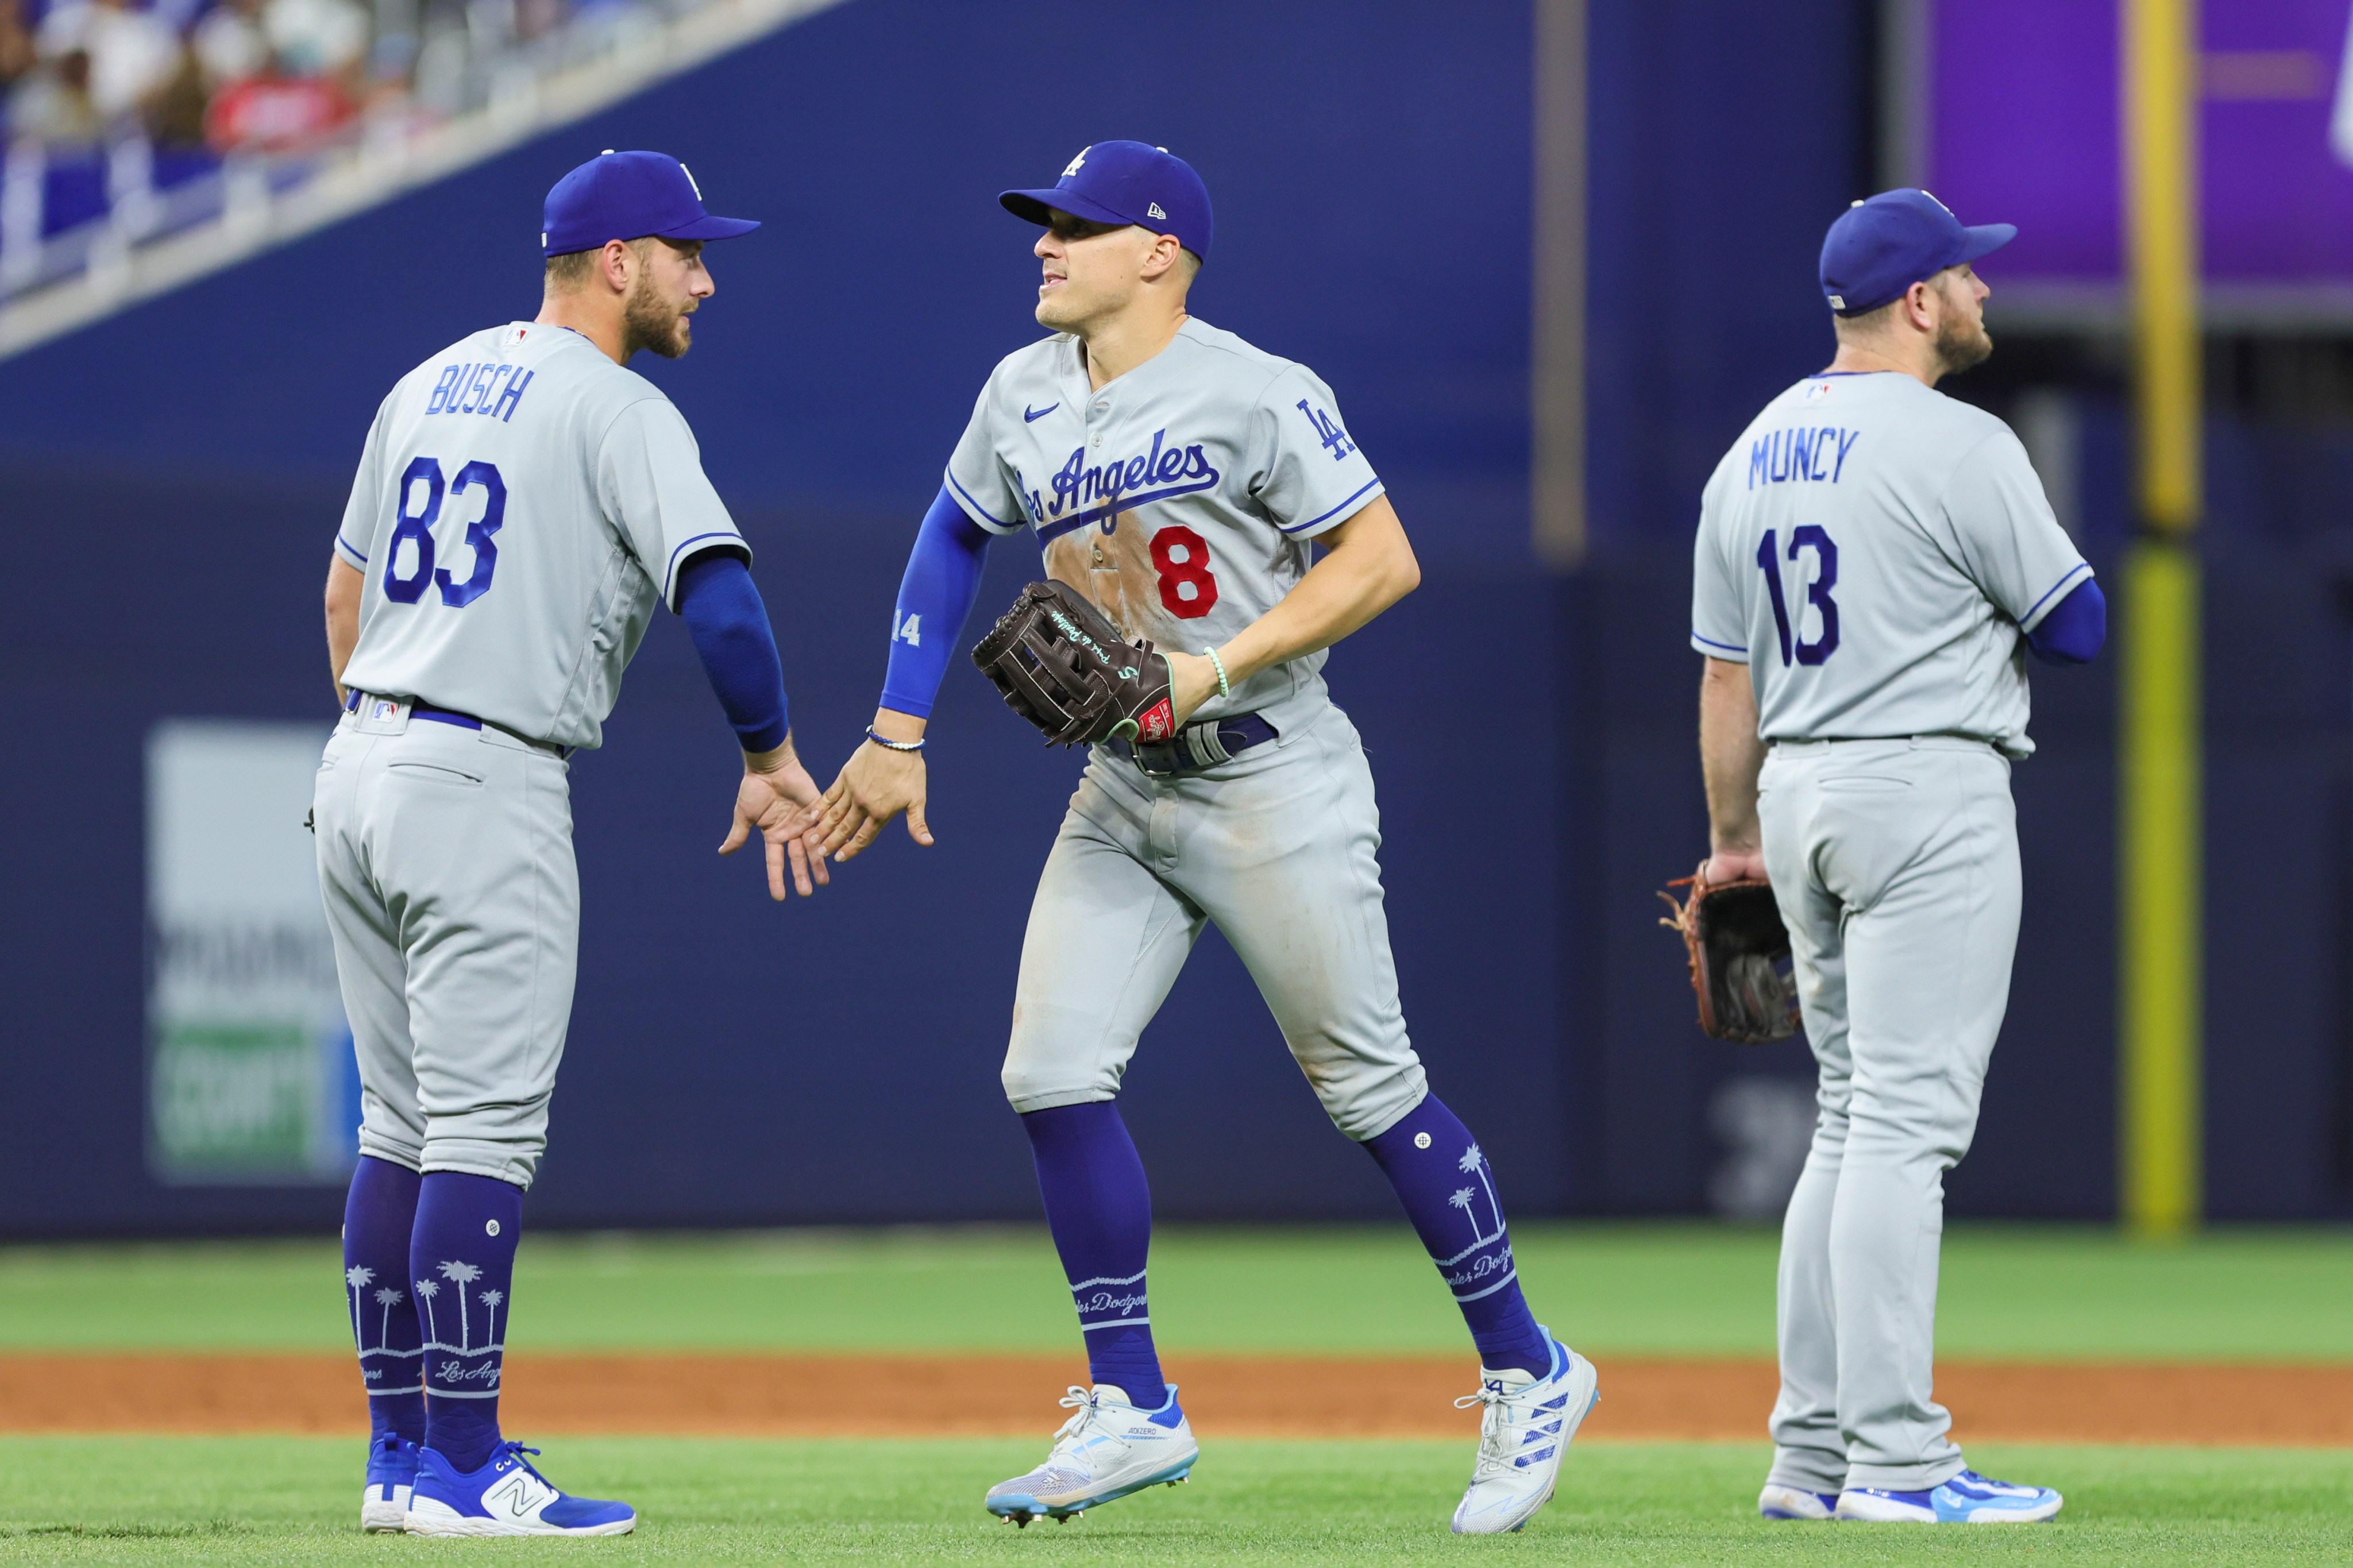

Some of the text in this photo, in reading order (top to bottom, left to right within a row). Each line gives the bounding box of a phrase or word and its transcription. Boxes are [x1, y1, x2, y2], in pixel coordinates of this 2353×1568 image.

[426, 364, 535, 423] BUSCH
[1297, 399, 1355, 461] LA
[1748, 427, 1860, 491] MUNCY
[1048, 428, 1219, 536] Angeles
[383, 457, 507, 608] 83
[1149, 526, 1218, 620] 8
[1757, 524, 1840, 667] 13
[435, 1361, 466, 1383] Los
[1128, 1427, 1156, 1436] ADIZERO
